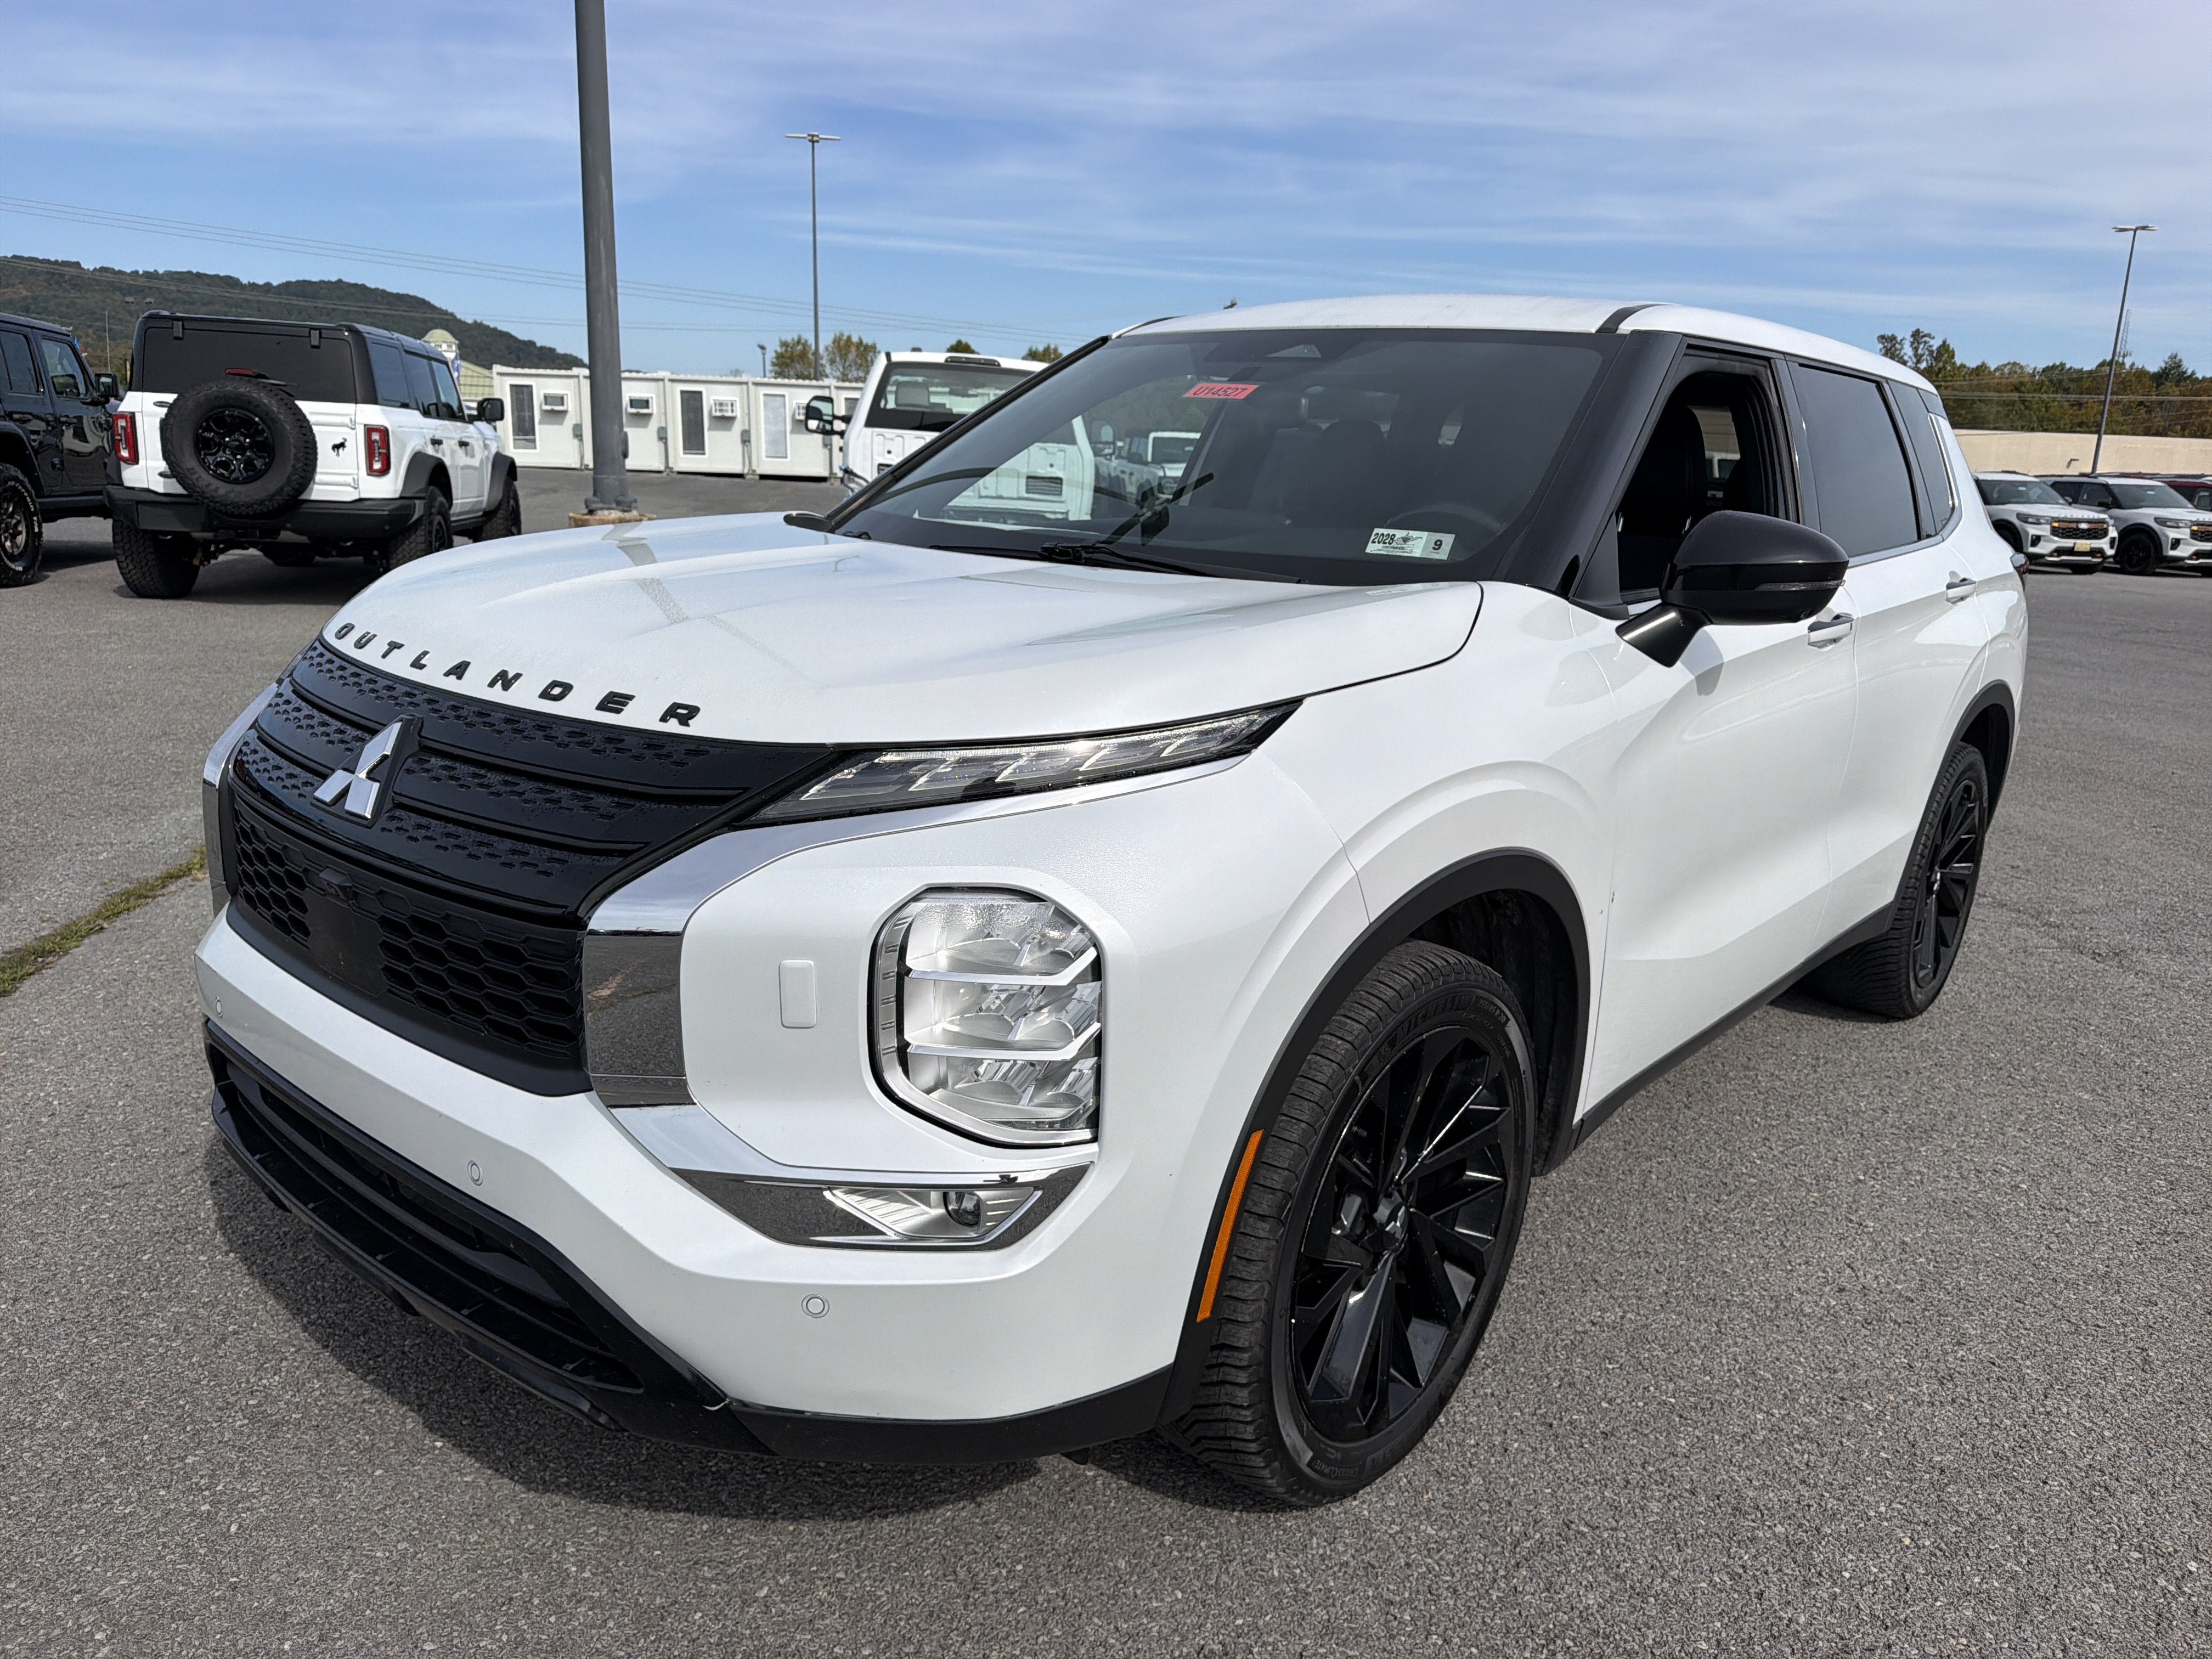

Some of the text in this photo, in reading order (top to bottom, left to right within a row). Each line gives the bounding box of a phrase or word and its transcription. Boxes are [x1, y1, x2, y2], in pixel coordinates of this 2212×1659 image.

[1193, 386, 1248, 397] U14527
[1371, 532, 1396, 545] 2028
[1432, 539, 1443, 551] 9
[334, 622, 701, 727] OUTLANDER
